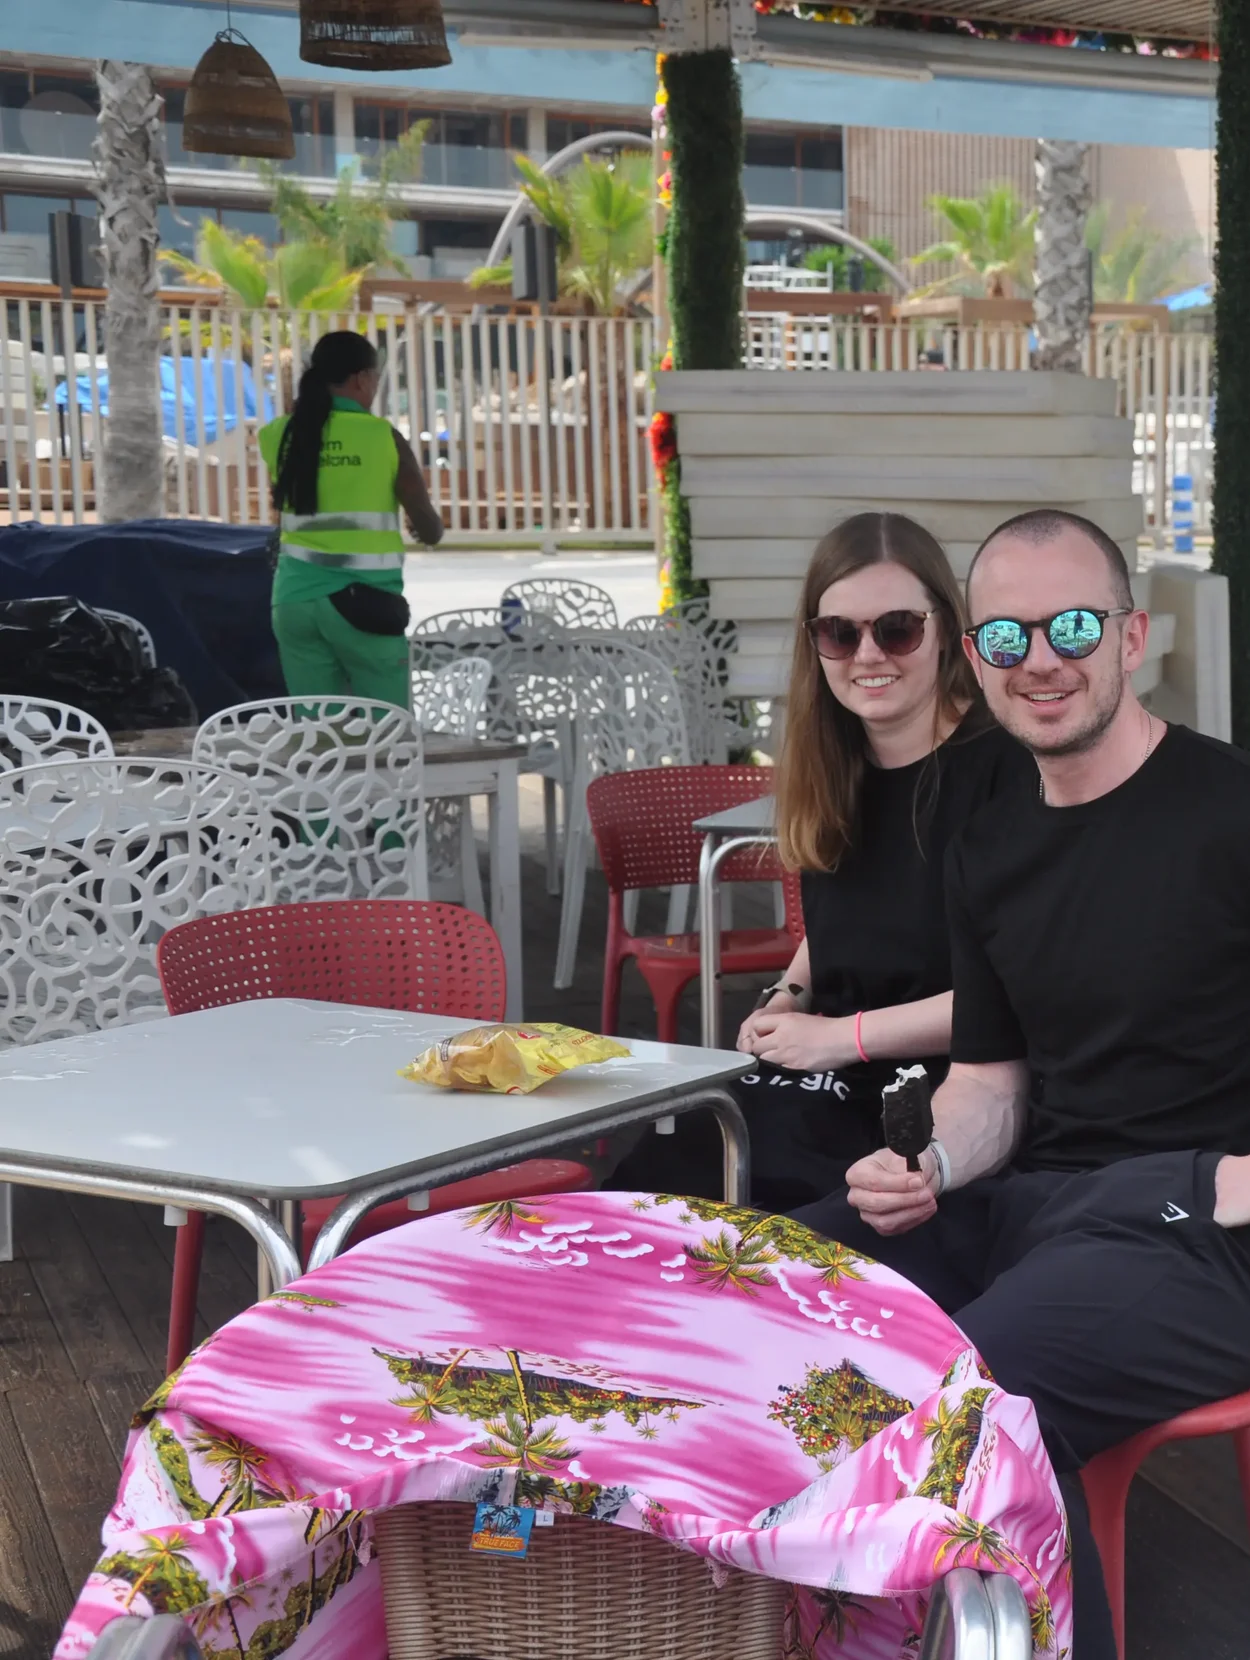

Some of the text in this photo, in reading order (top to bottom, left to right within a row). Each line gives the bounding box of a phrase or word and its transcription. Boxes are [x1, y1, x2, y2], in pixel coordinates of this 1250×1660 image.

[319, 454, 361, 467] elona
[480, 1537, 520, 1548] TRUE FACE
